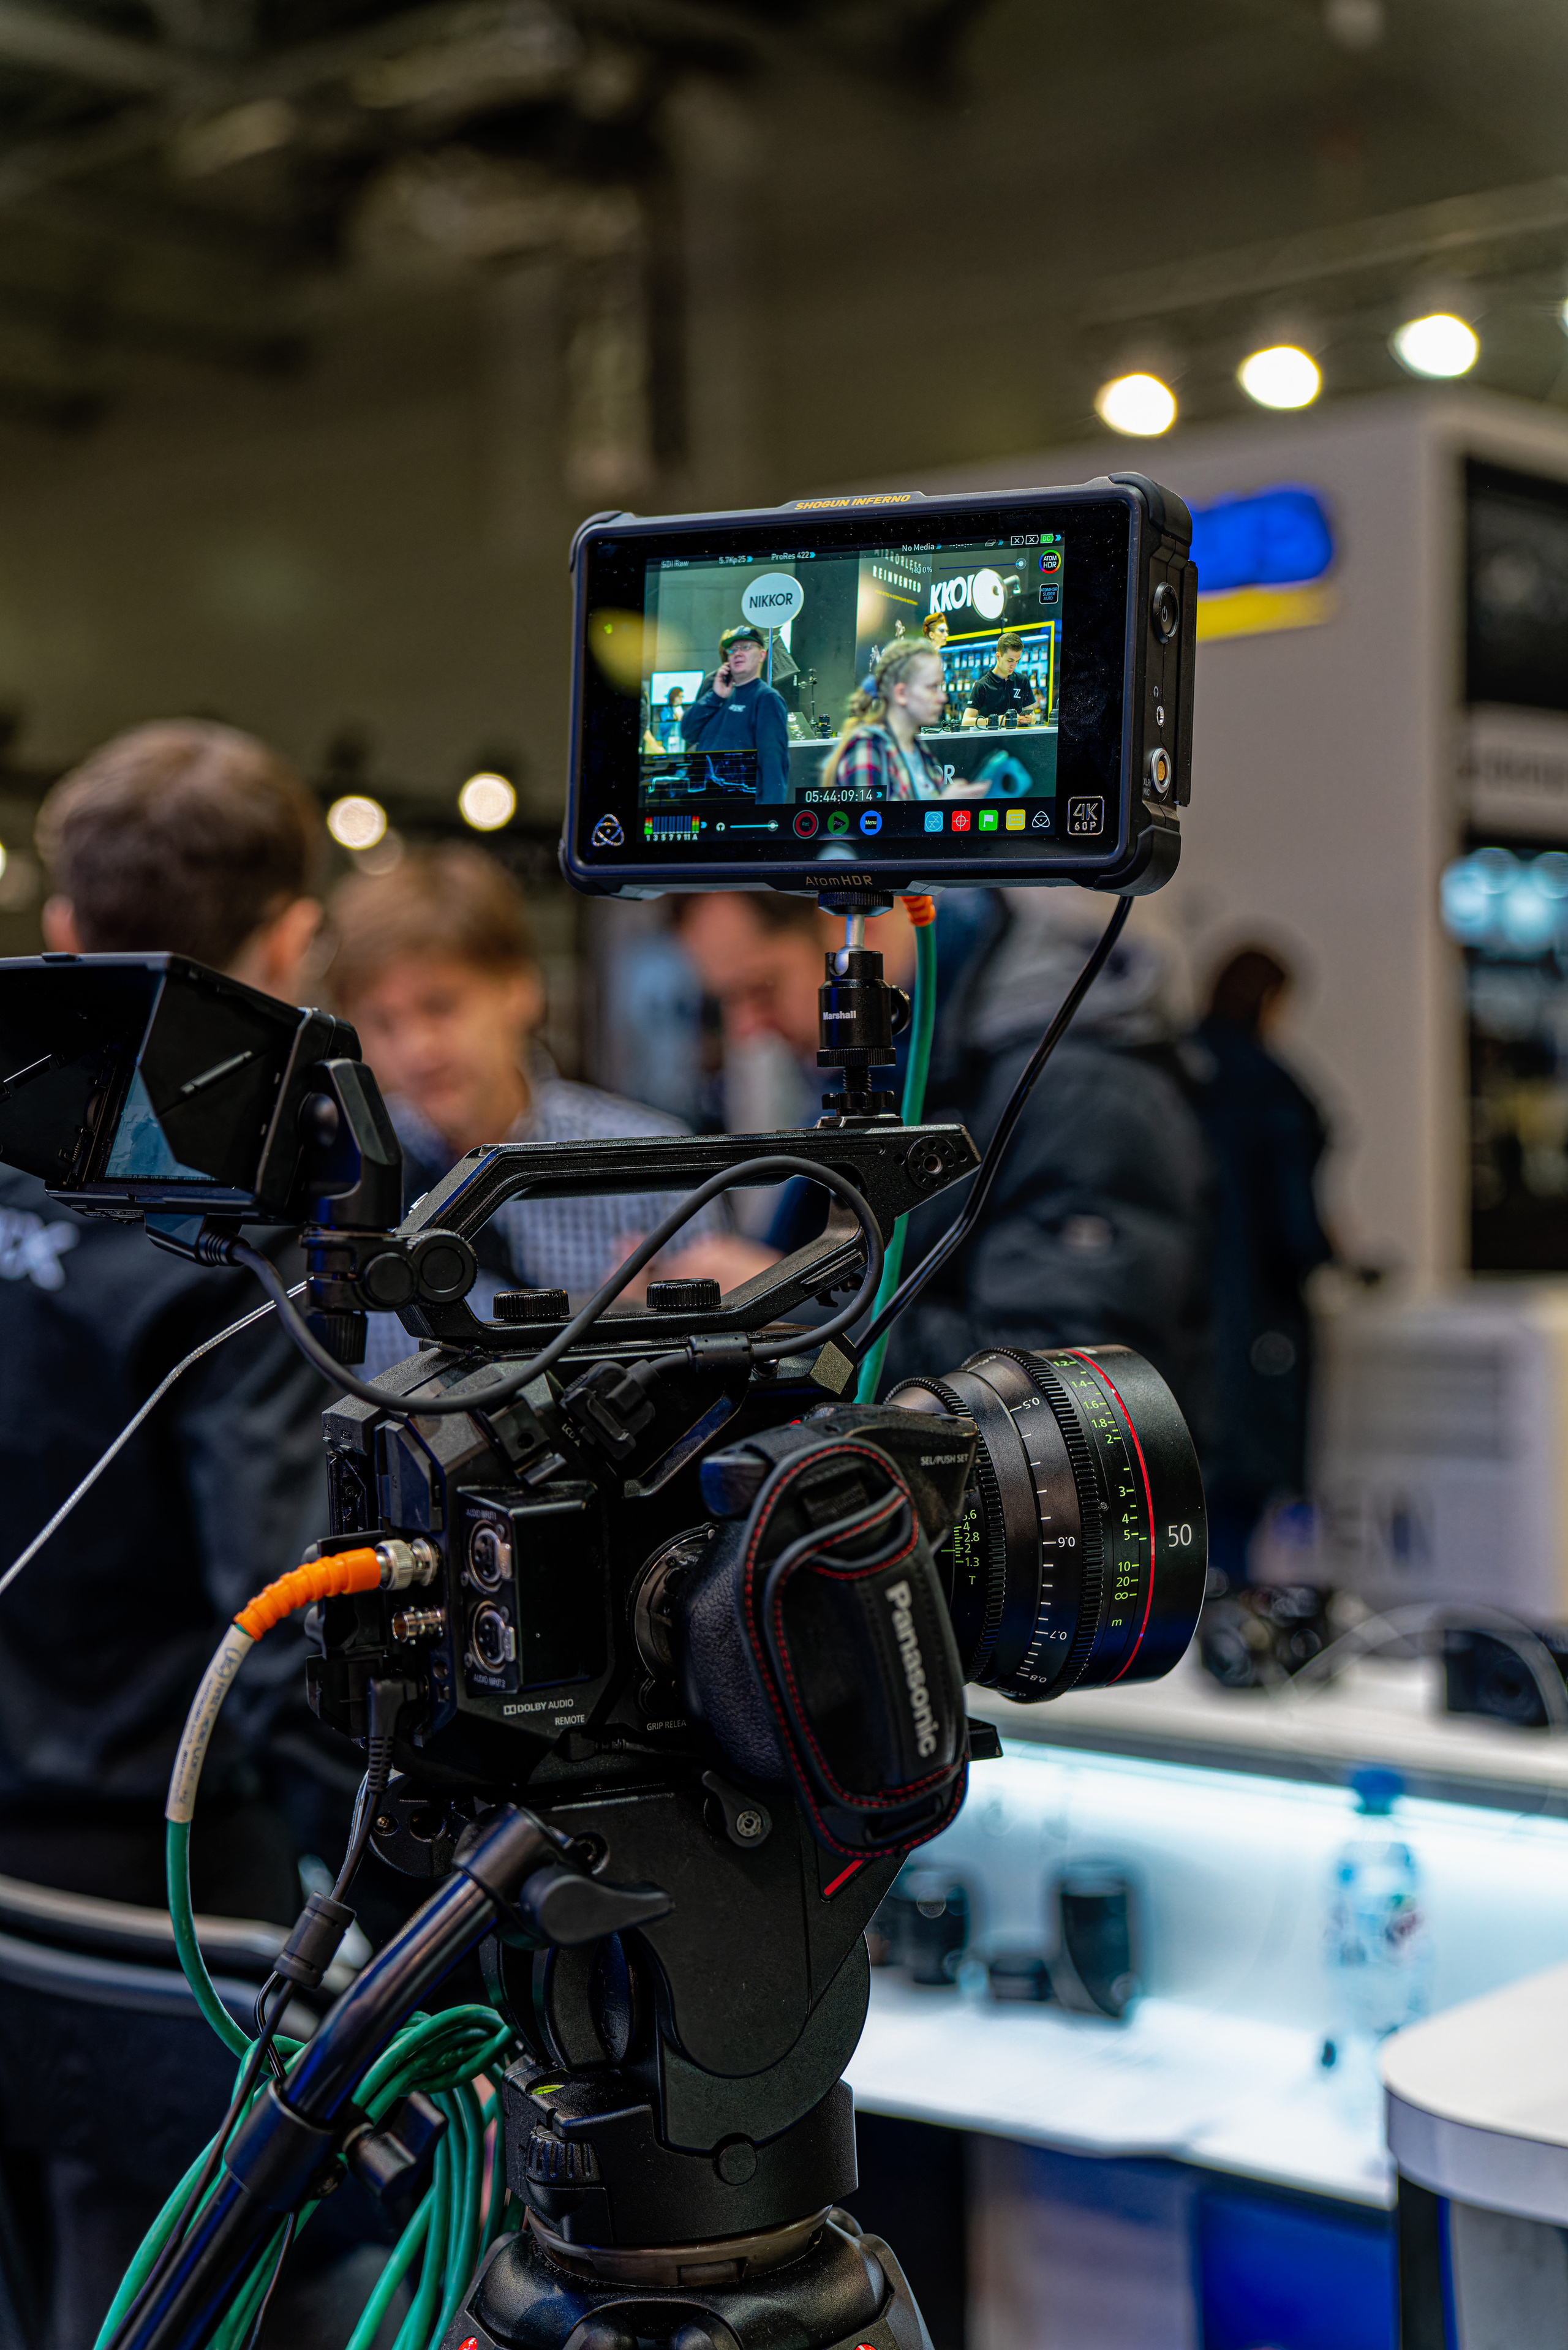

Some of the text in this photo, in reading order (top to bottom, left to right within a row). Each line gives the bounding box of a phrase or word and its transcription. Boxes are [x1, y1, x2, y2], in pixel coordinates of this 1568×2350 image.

[794, 494, 911, 510] SHOGUN INFERNO
[913, 543, 935, 551] Media
[872, 565, 921, 593] REINVENTED
[749, 593, 793, 608] NIKKOR
[805, 789, 873, 803] 05:44:09:14
[1073, 803, 1098, 820] 4K
[1074, 821, 1096, 831] 60P
[805, 875, 873, 886] AtomHDR
[823, 1011, 857, 1020] Marshall
[1022, 1397, 1040, 1409] 0.5
[1083, 1400, 1099, 1409] 1.6
[1091, 1418, 1108, 1428] 1.8
[561, 1423, 576, 1439] LCD
[1105, 1434, 1114, 1444] 2
[957, 1453, 969, 1463] SET
[1118, 1486, 1126, 1497] 3
[1121, 1513, 1129, 1524] 4
[963, 1521, 970, 1531] 4
[964, 1532, 980, 1542] 2.8
[1124, 1529, 1131, 1540] 5
[1168, 1524, 1192, 1547] 50
[1058, 1536, 1076, 1548] 0.6
[965, 1543, 971, 1553] 2
[965, 1557, 980, 1567] 1.3
[1118, 1561, 1131, 1572] 10
[968, 1575, 976, 1585] T
[1116, 1576, 1130, 1587] 20
[1050, 1631, 1067, 1640] 0.7
[885, 1580, 939, 1758] Panasonic
[1030, 1674, 1047, 1683] 0.8
[518, 1698, 574, 1714] DOLBY AUDIO
[555, 1714, 585, 1726] REMOTE
[647, 1720, 687, 1731] GRIP RELEA
